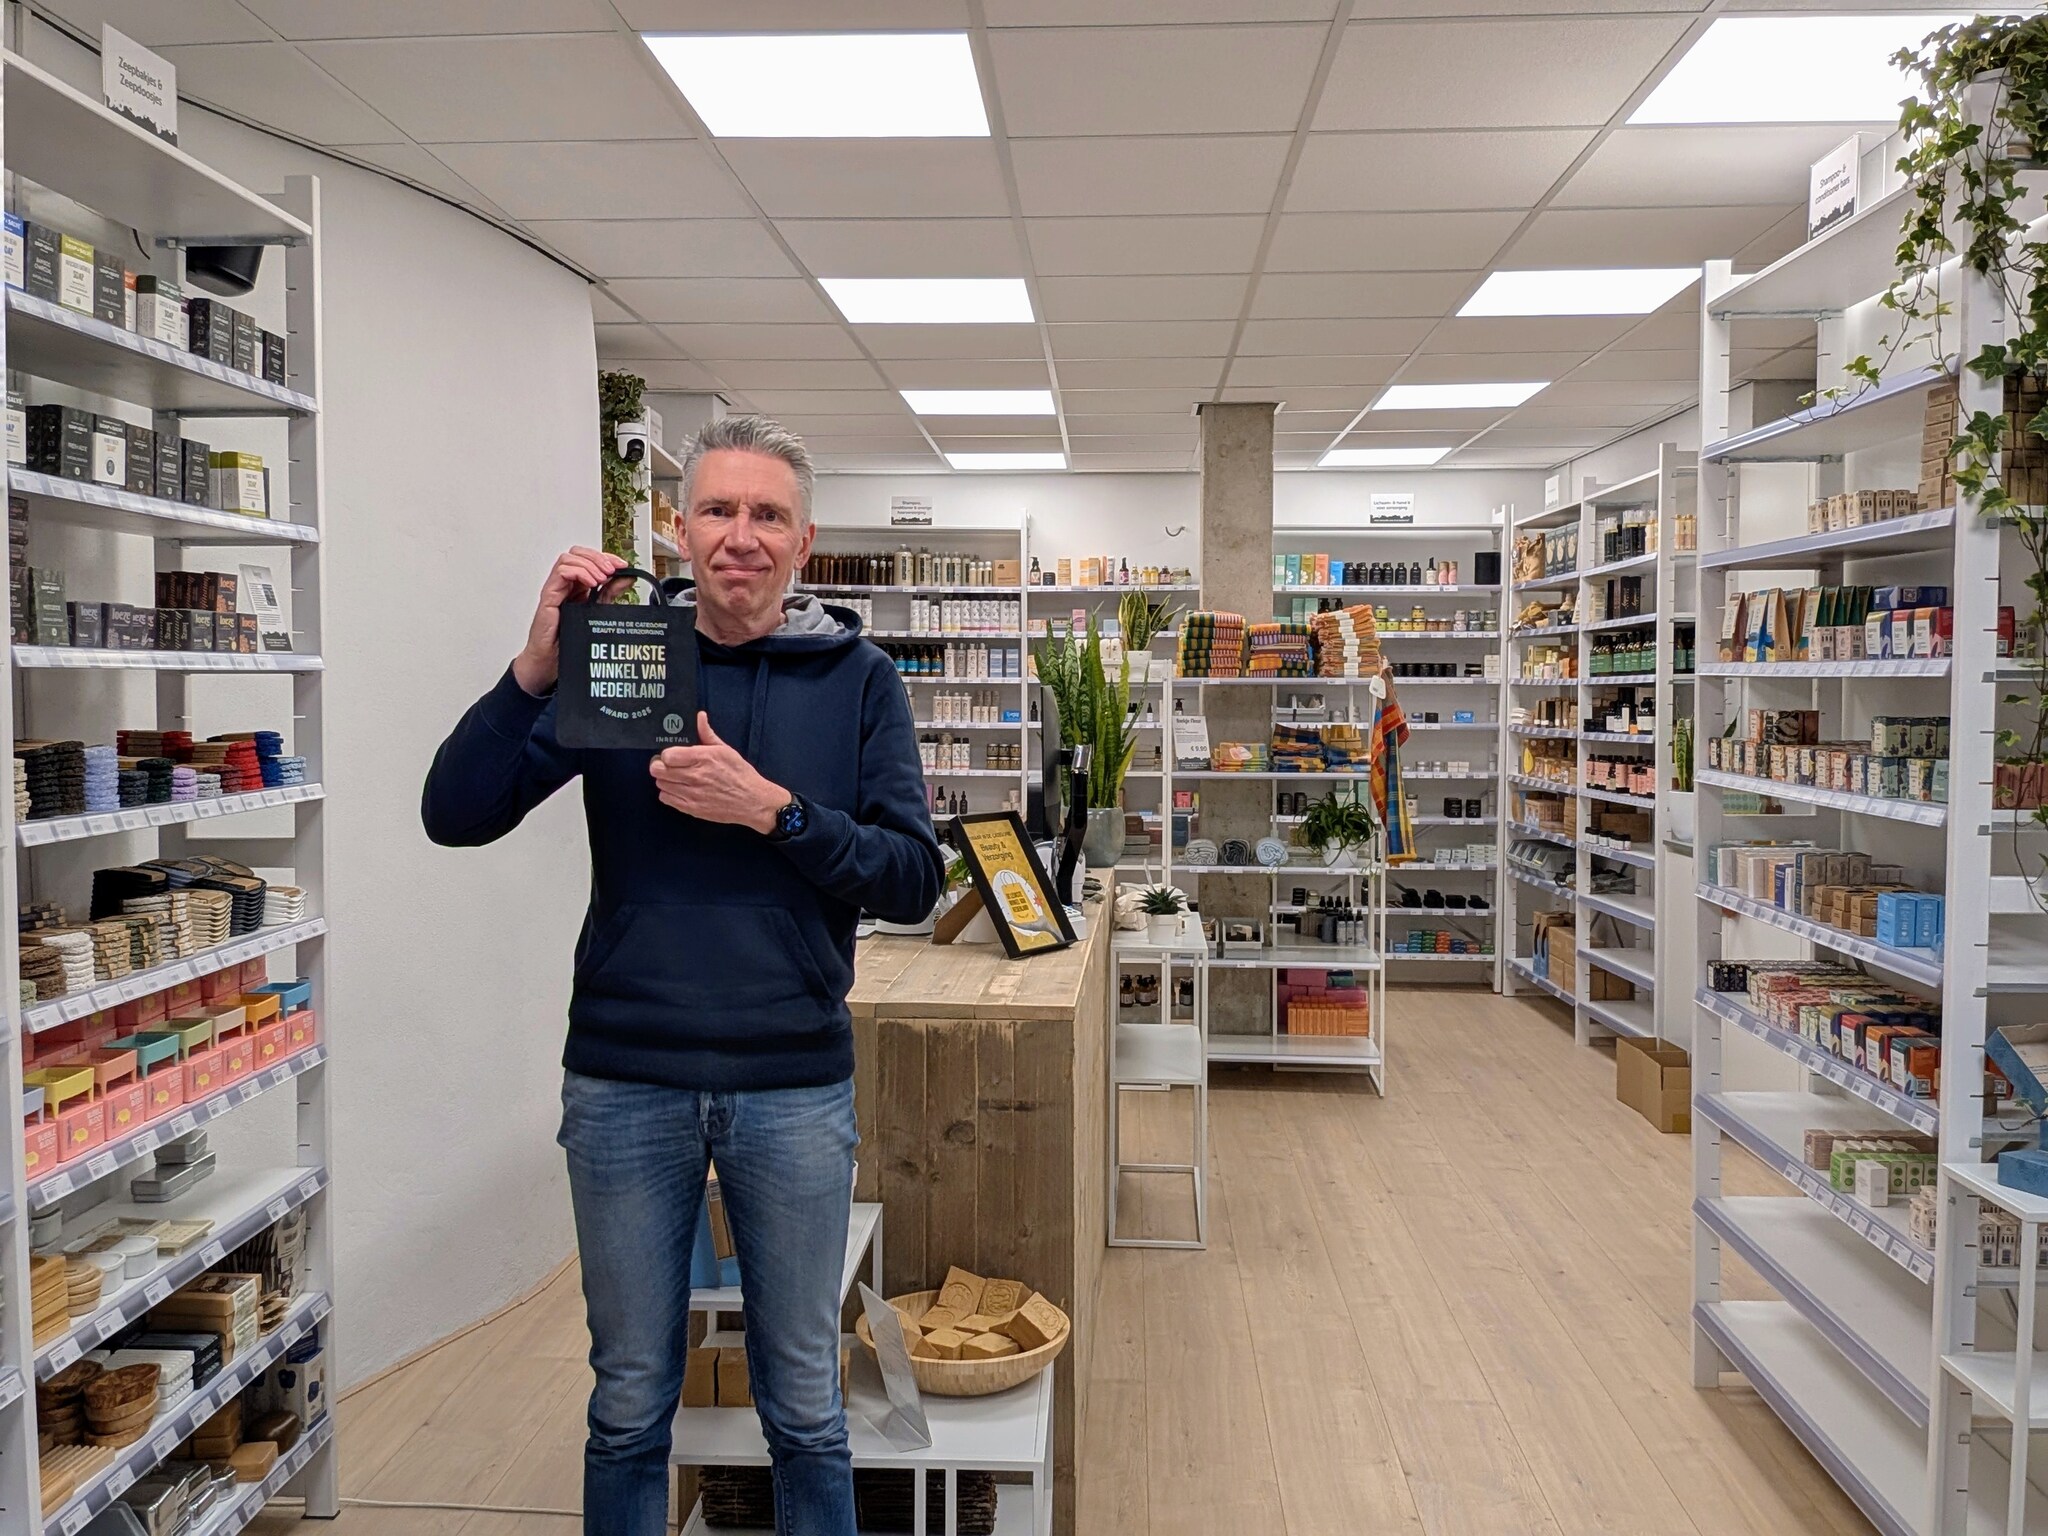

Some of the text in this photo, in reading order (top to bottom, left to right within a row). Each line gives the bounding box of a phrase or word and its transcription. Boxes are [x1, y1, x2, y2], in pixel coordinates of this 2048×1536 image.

[118, 56, 163, 91] Zeepbakjes &
[119, 73, 163, 107] Zeepdoosjes
[626, 628, 665, 636] VERZORGING
[635, 621, 668, 629] CATEGORIE
[591, 643, 666, 661] DE LEUKSTE
[590, 662, 666, 680] WINKEL VAN
[590, 681, 665, 699] NEDERLAND
[600, 705, 629, 719] AWARD
[667, 719, 680, 729] IN
[980, 842, 1001, 851] Beauty
[981, 851, 1015, 862] Verzorging
